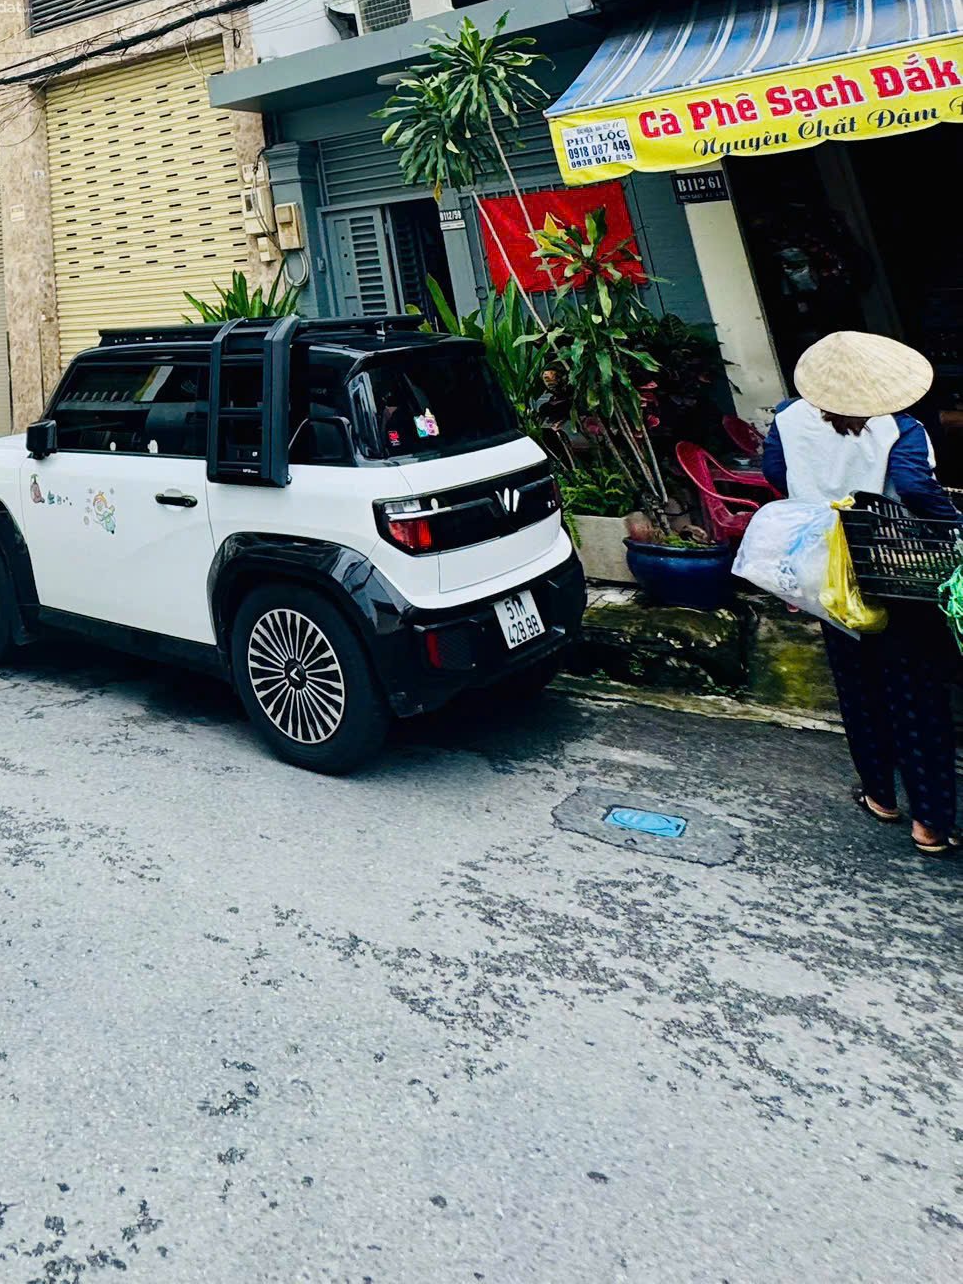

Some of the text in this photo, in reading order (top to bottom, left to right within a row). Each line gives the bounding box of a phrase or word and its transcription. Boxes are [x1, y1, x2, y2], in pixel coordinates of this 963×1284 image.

[638, 53, 961, 139] Cà Phê Sạch Đắk
[598, 129, 626, 143] LỘC
[693, 107, 941, 156] Nguyên Chất Đậm
[568, 146, 589, 160] 0918
[612, 139, 631, 152] 449
[508, 614, 541, 645] 428.88
